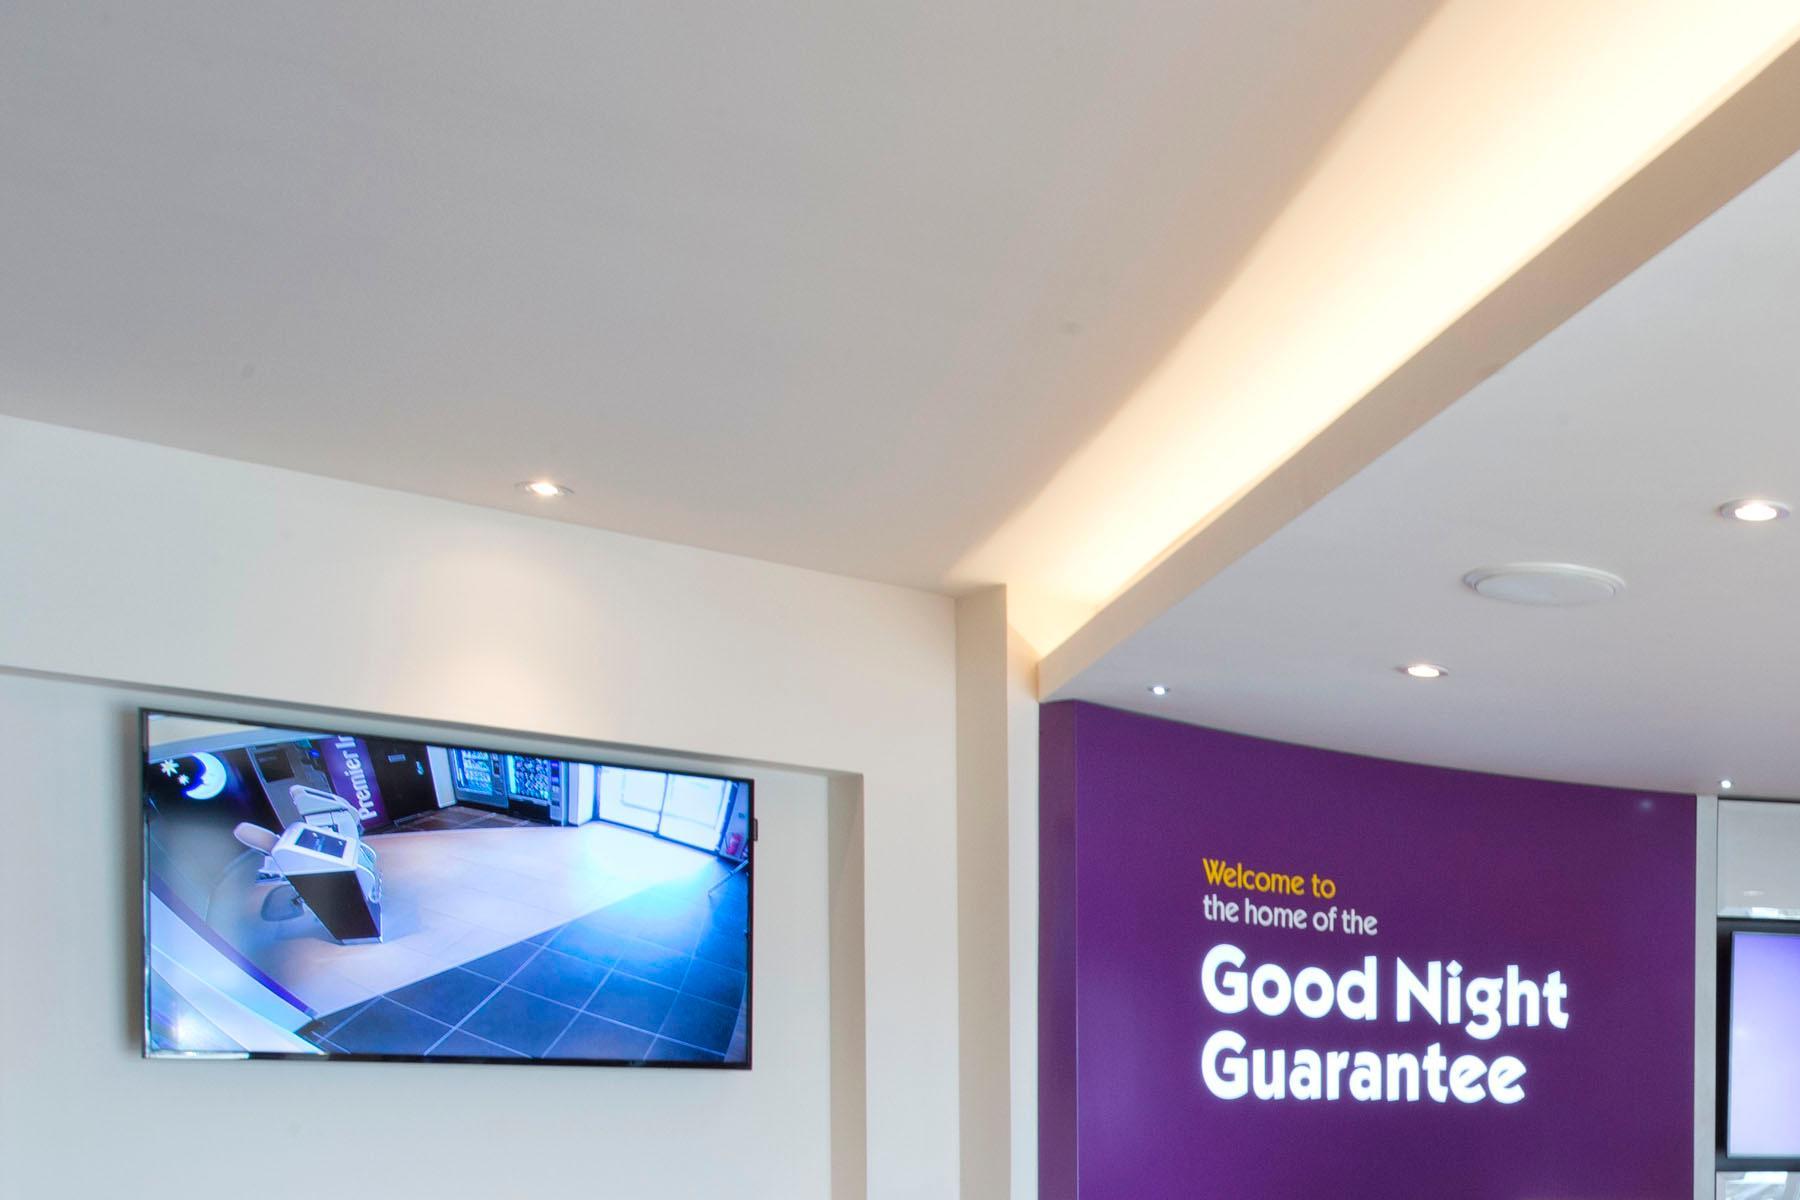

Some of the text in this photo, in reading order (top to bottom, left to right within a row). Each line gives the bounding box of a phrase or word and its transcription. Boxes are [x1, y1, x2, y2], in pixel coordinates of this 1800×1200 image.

[343, 750, 378, 820] Premier
[1202, 857, 1337, 899] Welcome to
[1203, 893, 1378, 936] the home of the
[1201, 943, 1570, 1041] Good Night
[1201, 1029, 1527, 1104] Guarantee
